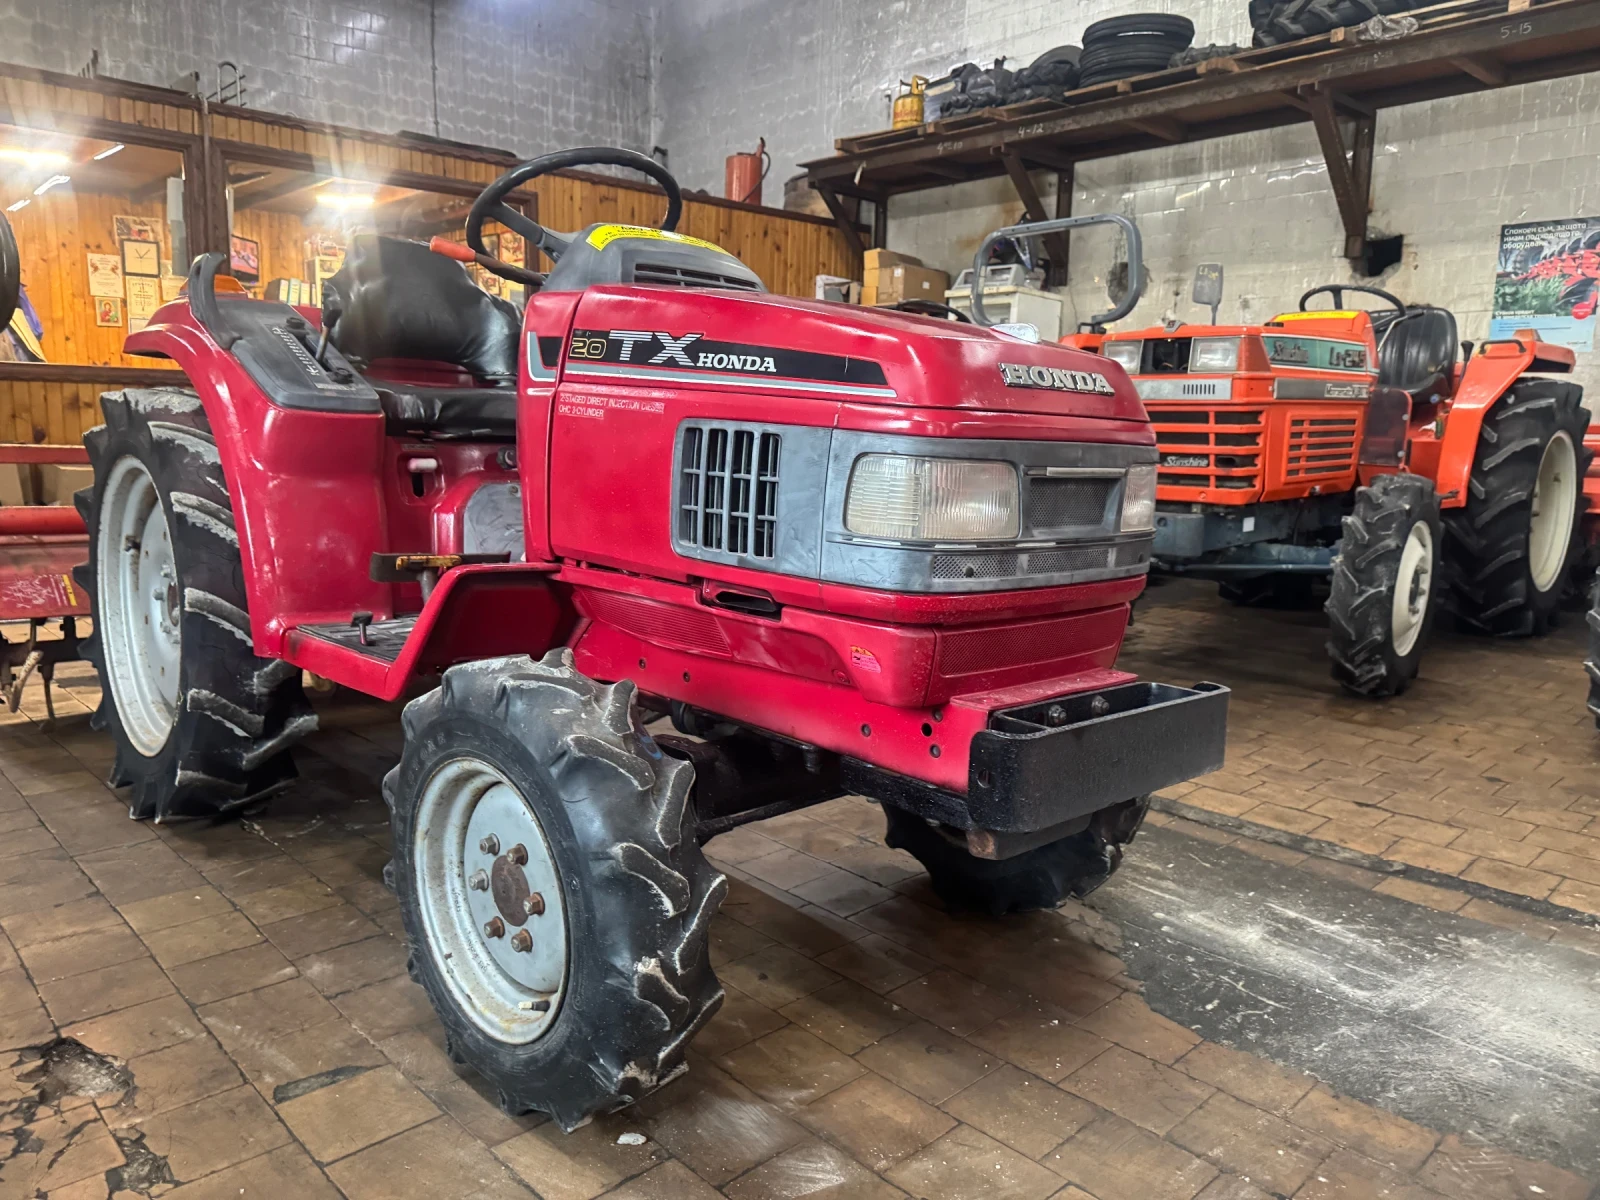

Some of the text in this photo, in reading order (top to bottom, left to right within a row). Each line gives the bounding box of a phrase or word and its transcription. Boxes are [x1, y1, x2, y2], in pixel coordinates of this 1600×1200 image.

[1500, 22, 1532, 39] 5-15
[1018, 124, 1044, 138] 4-12
[1504, 227, 1537, 236] Спокоен
[1555, 223, 1587, 232] защото
[569, 329, 777, 373] 20 TX HONDA
[998, 362, 1115, 396] HONDA
[558, 404, 571, 413] OHC
[587, 397, 608, 407] DIRECT
[1164, 455, 1209, 467] Sunshine
